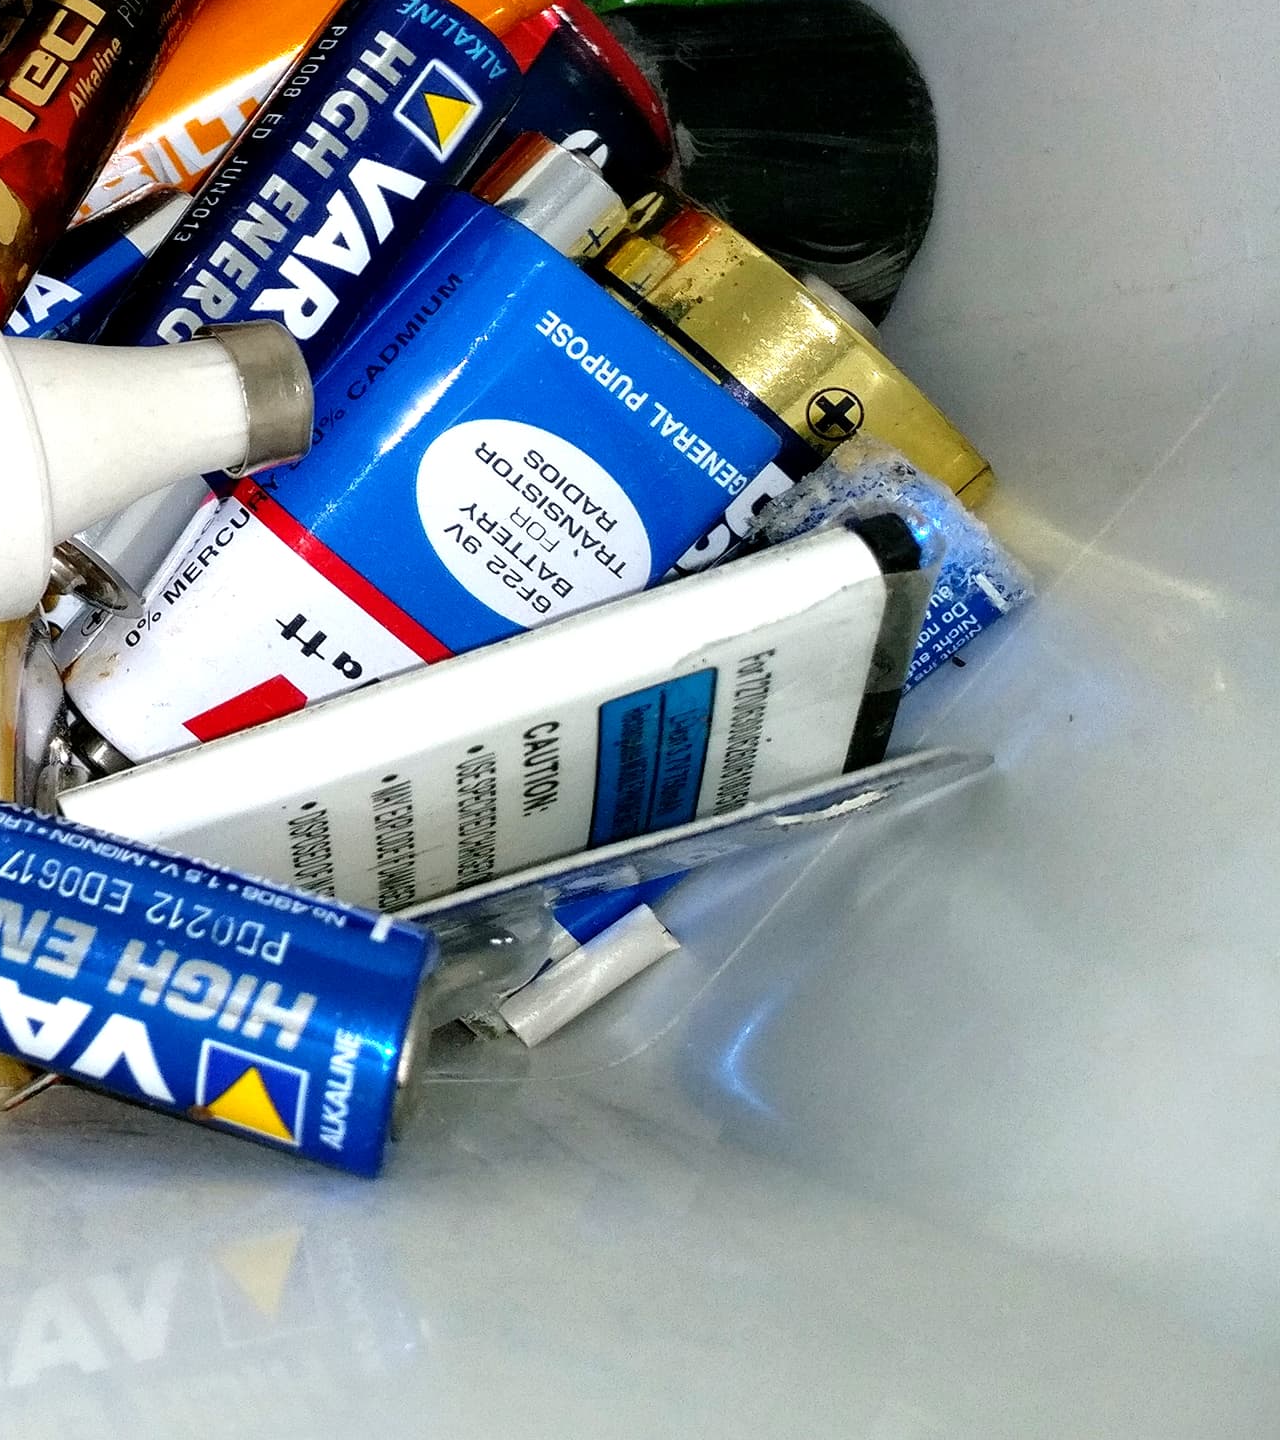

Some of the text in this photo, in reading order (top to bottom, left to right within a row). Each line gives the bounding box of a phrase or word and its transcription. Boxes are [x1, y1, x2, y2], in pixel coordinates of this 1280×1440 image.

[68, 37, 124, 118] Alkaline
[282, 21, 348, 102] PD1008
[290, 28, 418, 180] HIGH
[154, 171, 311, 345] ENERG
[249, 156, 428, 343] VAR
[345, 270, 464, 403] CADMIUM
[536, 309, 747, 496] GENERAL PURPOSE
[473, 440, 628, 581] TRANSISTOR
[511, 505, 560, 554] FOR
[523, 448, 619, 535] RADIOS
[123, 477, 281, 649] 0% MERCURY
[443, 520, 554, 615] 6F22 9V
[458, 502, 575, 599] BATTERY
[521, 721, 561, 817] CAUTION:
[145, 890, 293, 966] PD0212
[106, 938, 318, 1052] HIGH
